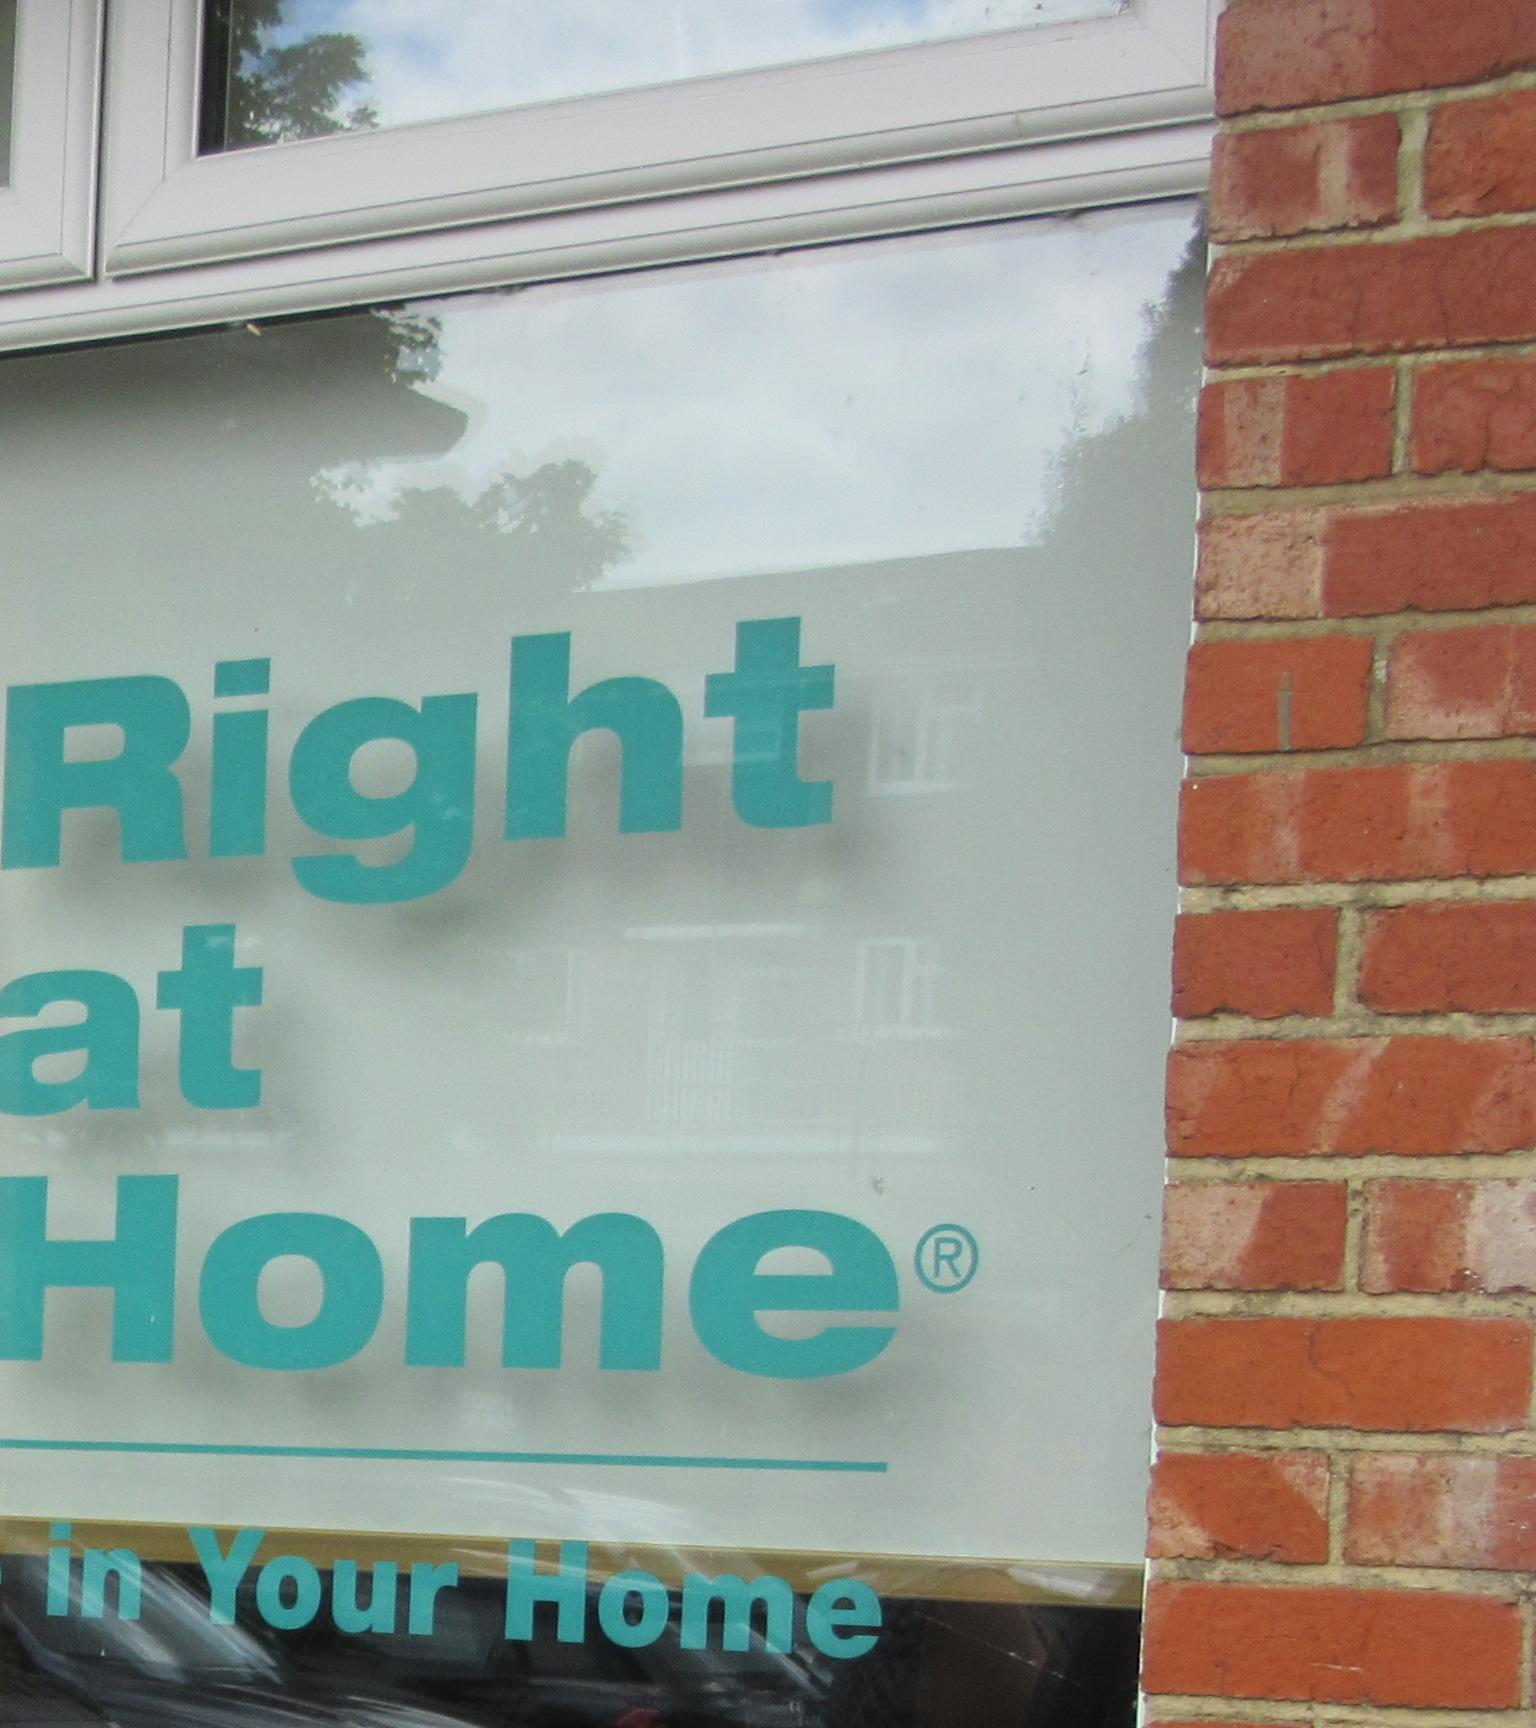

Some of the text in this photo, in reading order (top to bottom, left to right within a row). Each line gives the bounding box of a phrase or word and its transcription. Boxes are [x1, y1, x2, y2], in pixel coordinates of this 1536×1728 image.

[1, 615, 836, 905] Right
[45, 1521, 144, 1621] in
[187, 1526, 459, 1637] Your
[503, 1538, 884, 1660] Home
